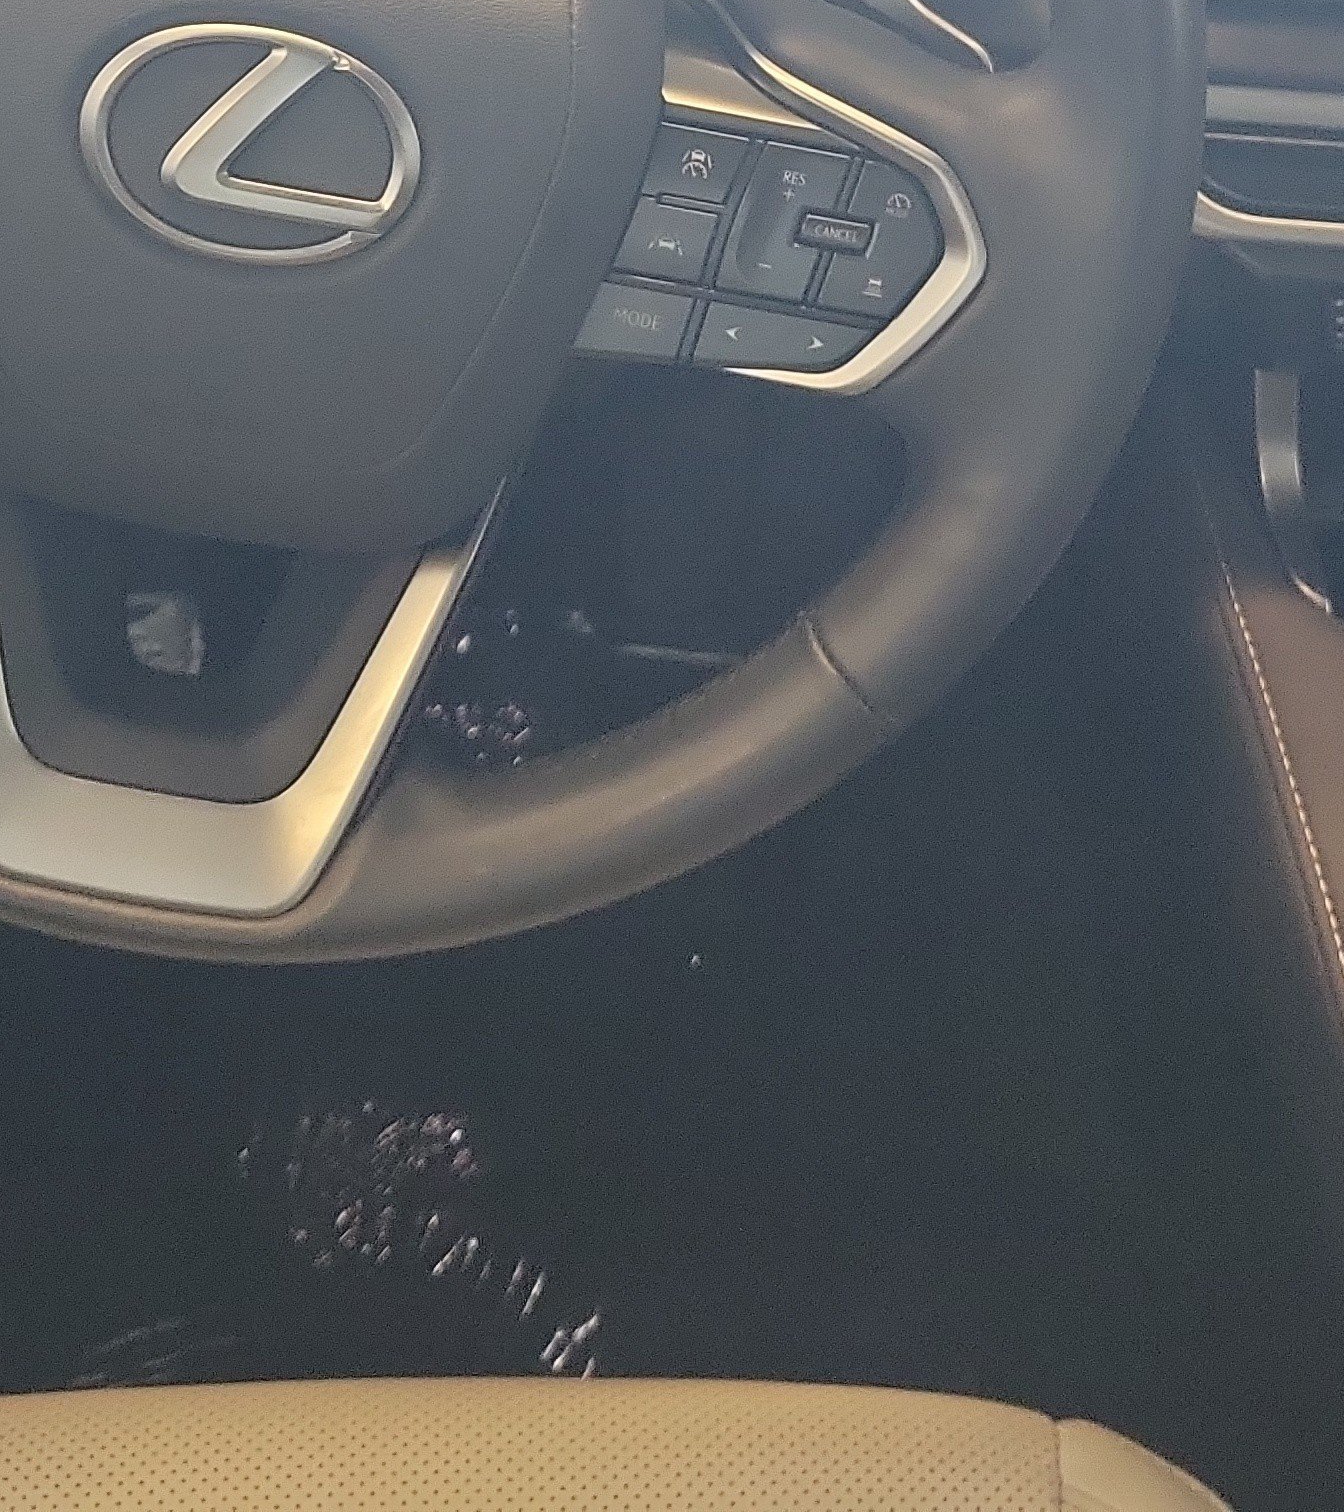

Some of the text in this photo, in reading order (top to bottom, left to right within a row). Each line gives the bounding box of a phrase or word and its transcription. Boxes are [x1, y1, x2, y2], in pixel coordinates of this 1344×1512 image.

[782, 170, 806, 186] RES
[813, 224, 861, 244] CANCEL
[613, 306, 664, 331] MODE
